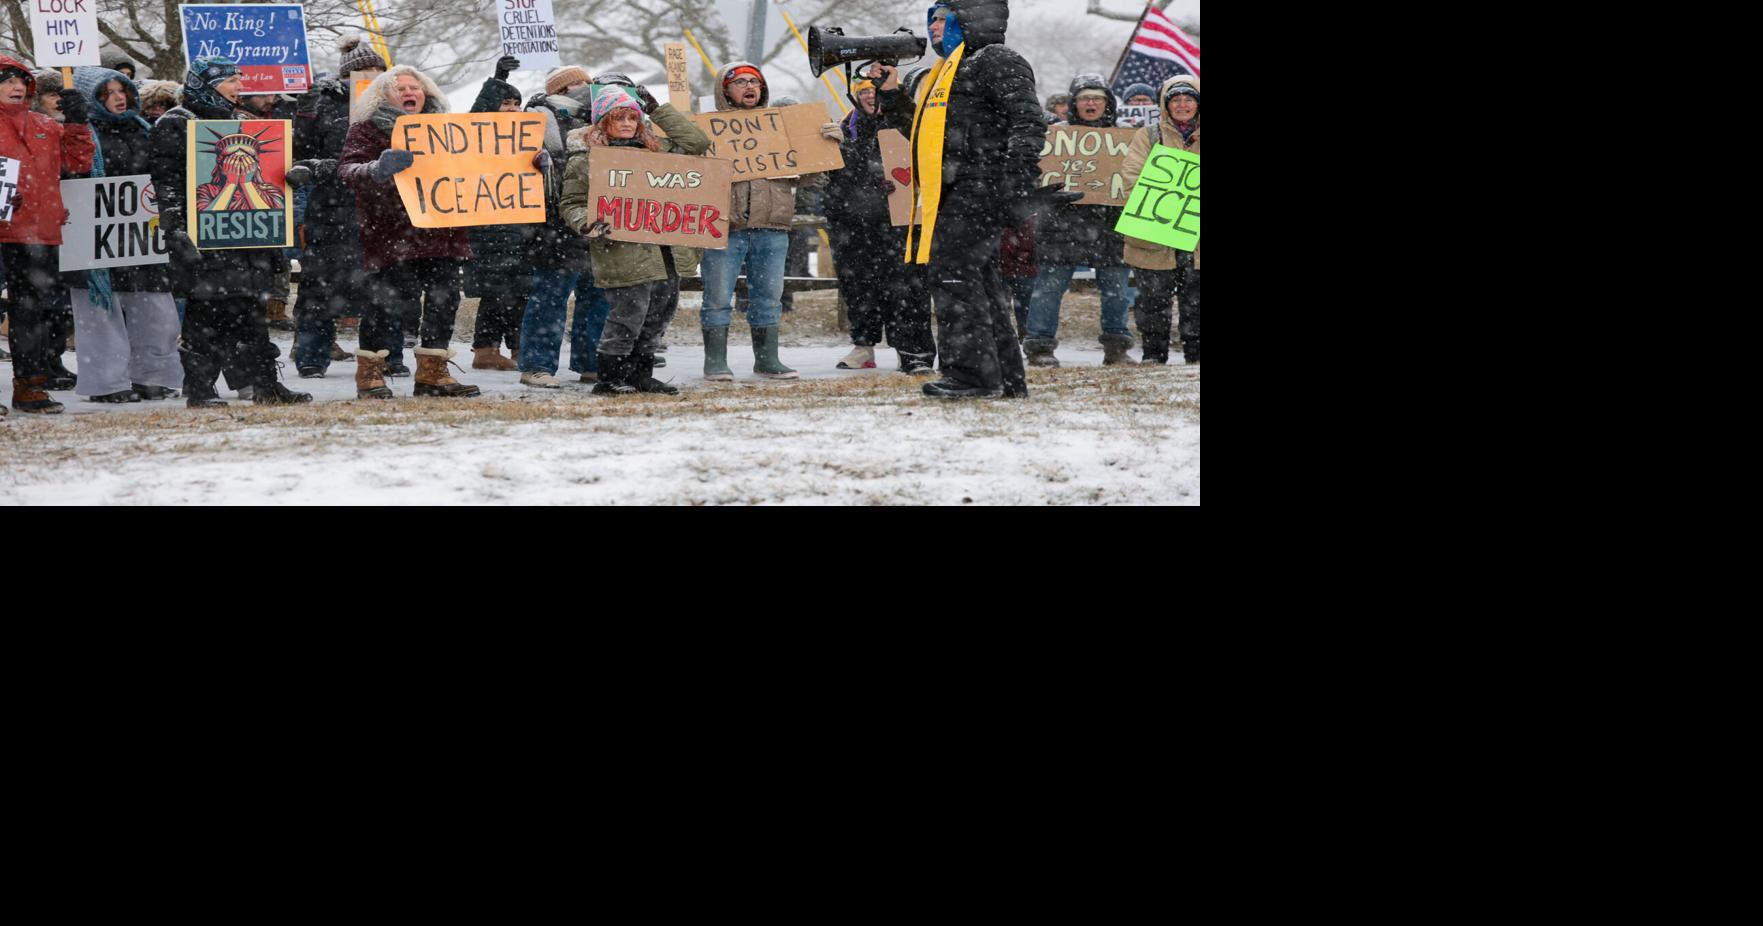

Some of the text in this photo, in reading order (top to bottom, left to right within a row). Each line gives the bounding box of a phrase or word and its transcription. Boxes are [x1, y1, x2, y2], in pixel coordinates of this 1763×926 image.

[38, 0, 87, 13] LOCK
[47, 19, 79, 36] HIM
[191, 12, 218, 31] No
[503, 10, 545, 25] CRUEL
[502, 24, 556, 40] DETENTIONS
[55, 40, 83, 56] UP!
[196, 38, 300, 64] No Tyranny!
[503, 40, 559, 56] DEPORTATIONS
[709, 112, 780, 136] DONT
[402, 120, 542, 156] END THE
[728, 137, 759, 153] TO
[732, 149, 799, 175] CISTS
[1061, 159, 1097, 173] yes
[608, 169, 703, 190] IT WAS
[1041, 171, 1082, 193] CE
[94, 181, 138, 219] NO
[415, 172, 542, 215] ICE AGE
[596, 195, 724, 240] MURDER
[1125, 181, 1200, 236] ICE
[199, 211, 284, 240] RESIST
